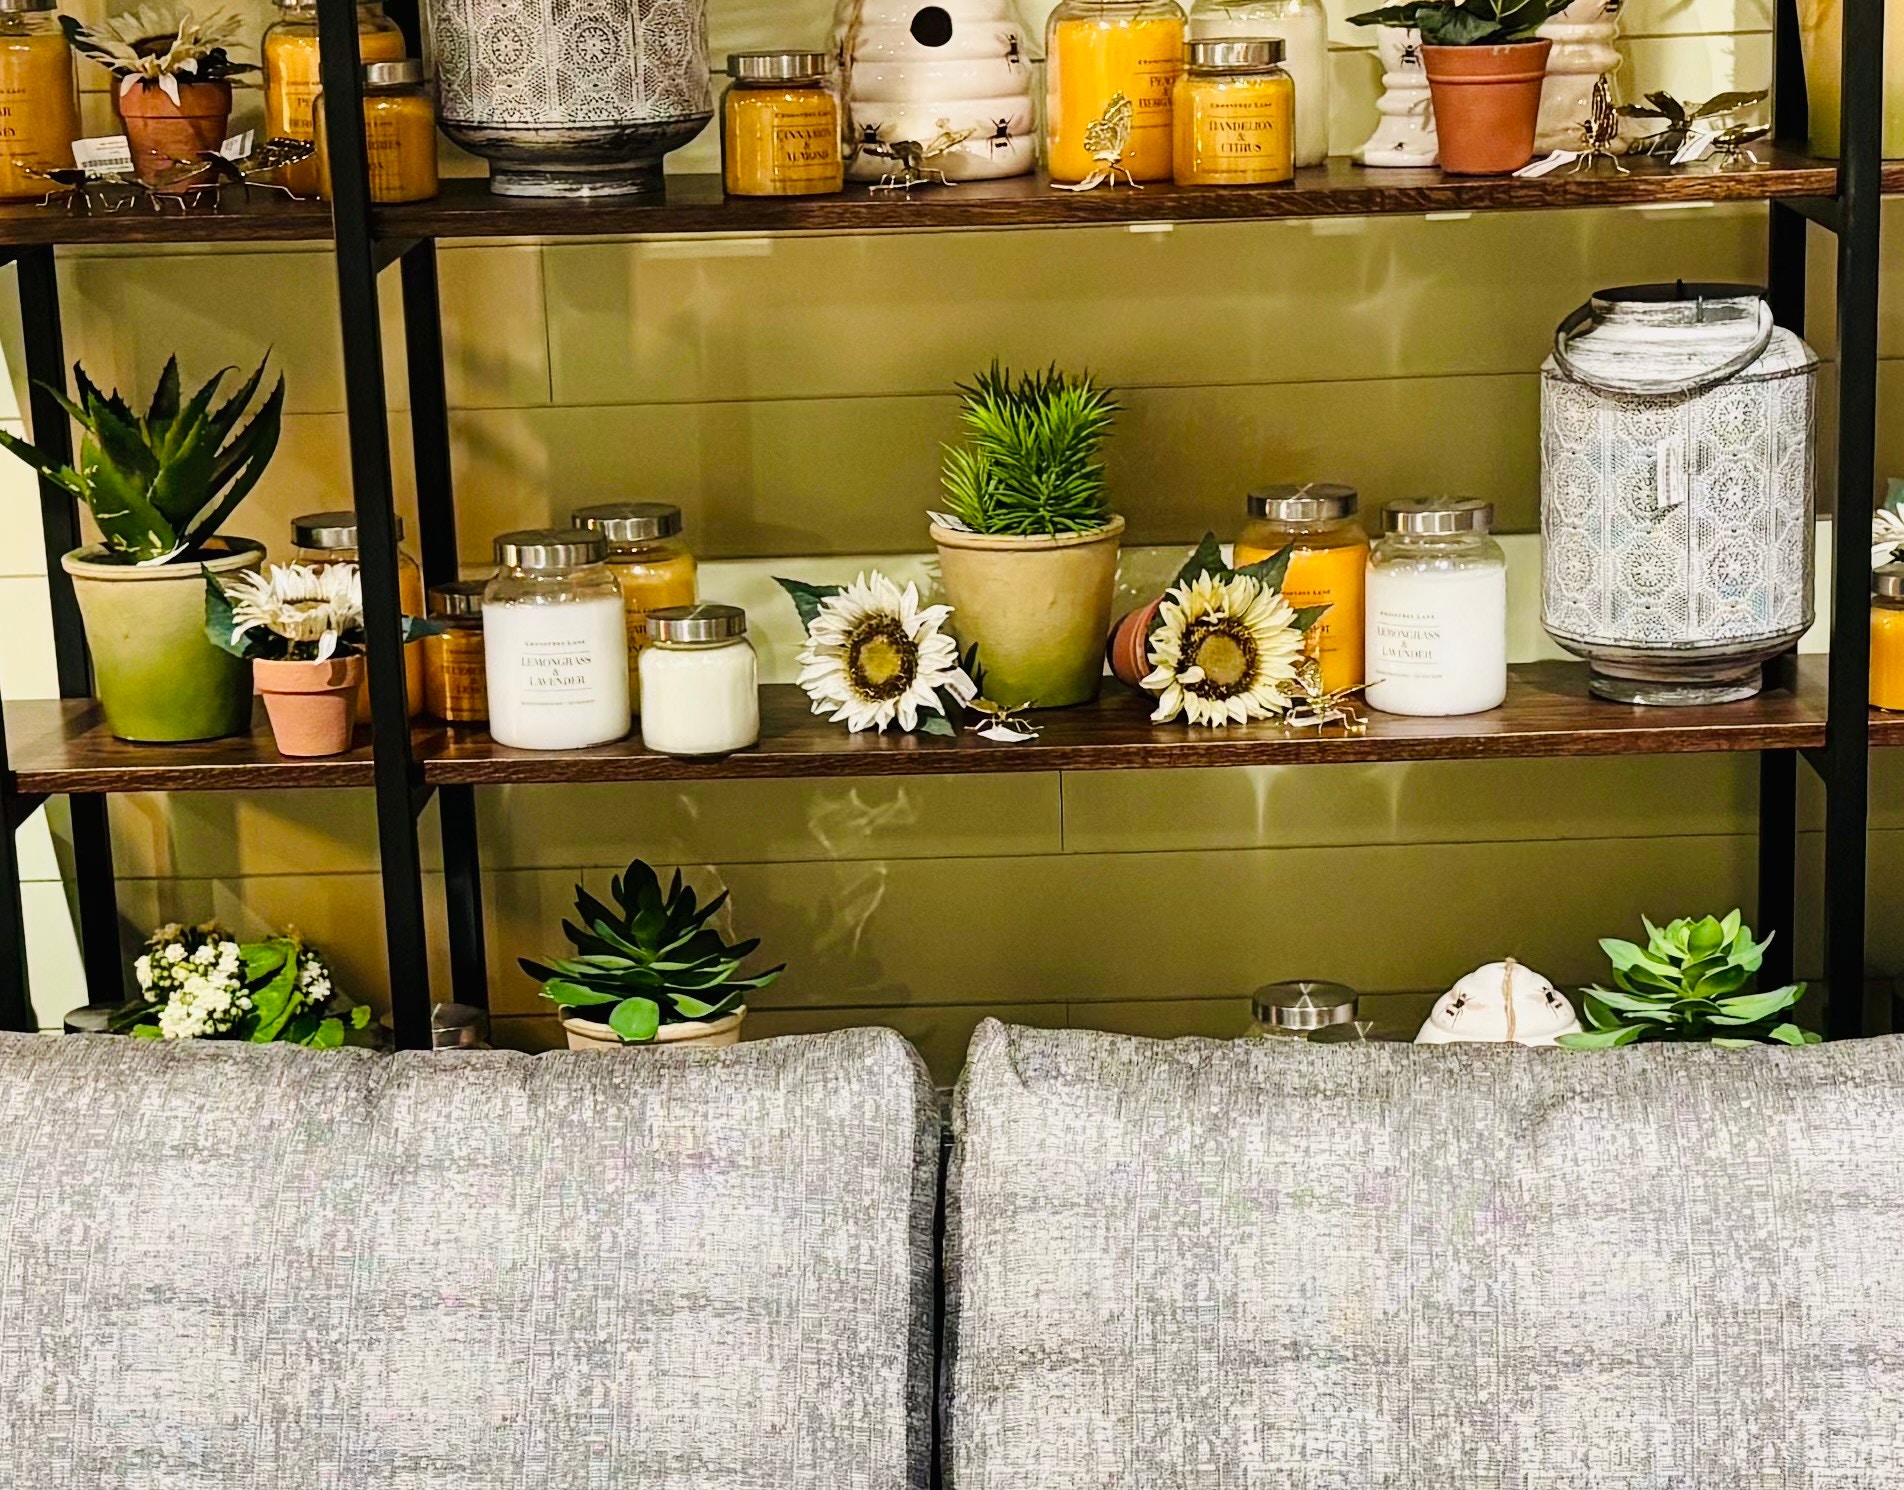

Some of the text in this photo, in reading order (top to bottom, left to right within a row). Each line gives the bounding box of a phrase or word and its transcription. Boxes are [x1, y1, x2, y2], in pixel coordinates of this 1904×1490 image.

[1209, 120, 1273, 131] DANDELION
[1221, 143, 1262, 153] CITRUS
[1377, 626, 1441, 640] LEMONGRASS
[1382, 648, 1433, 660] LAVENDER
[521, 656, 592, 667] LEMONGRASS
[529, 675, 586, 687] LAVENDER
